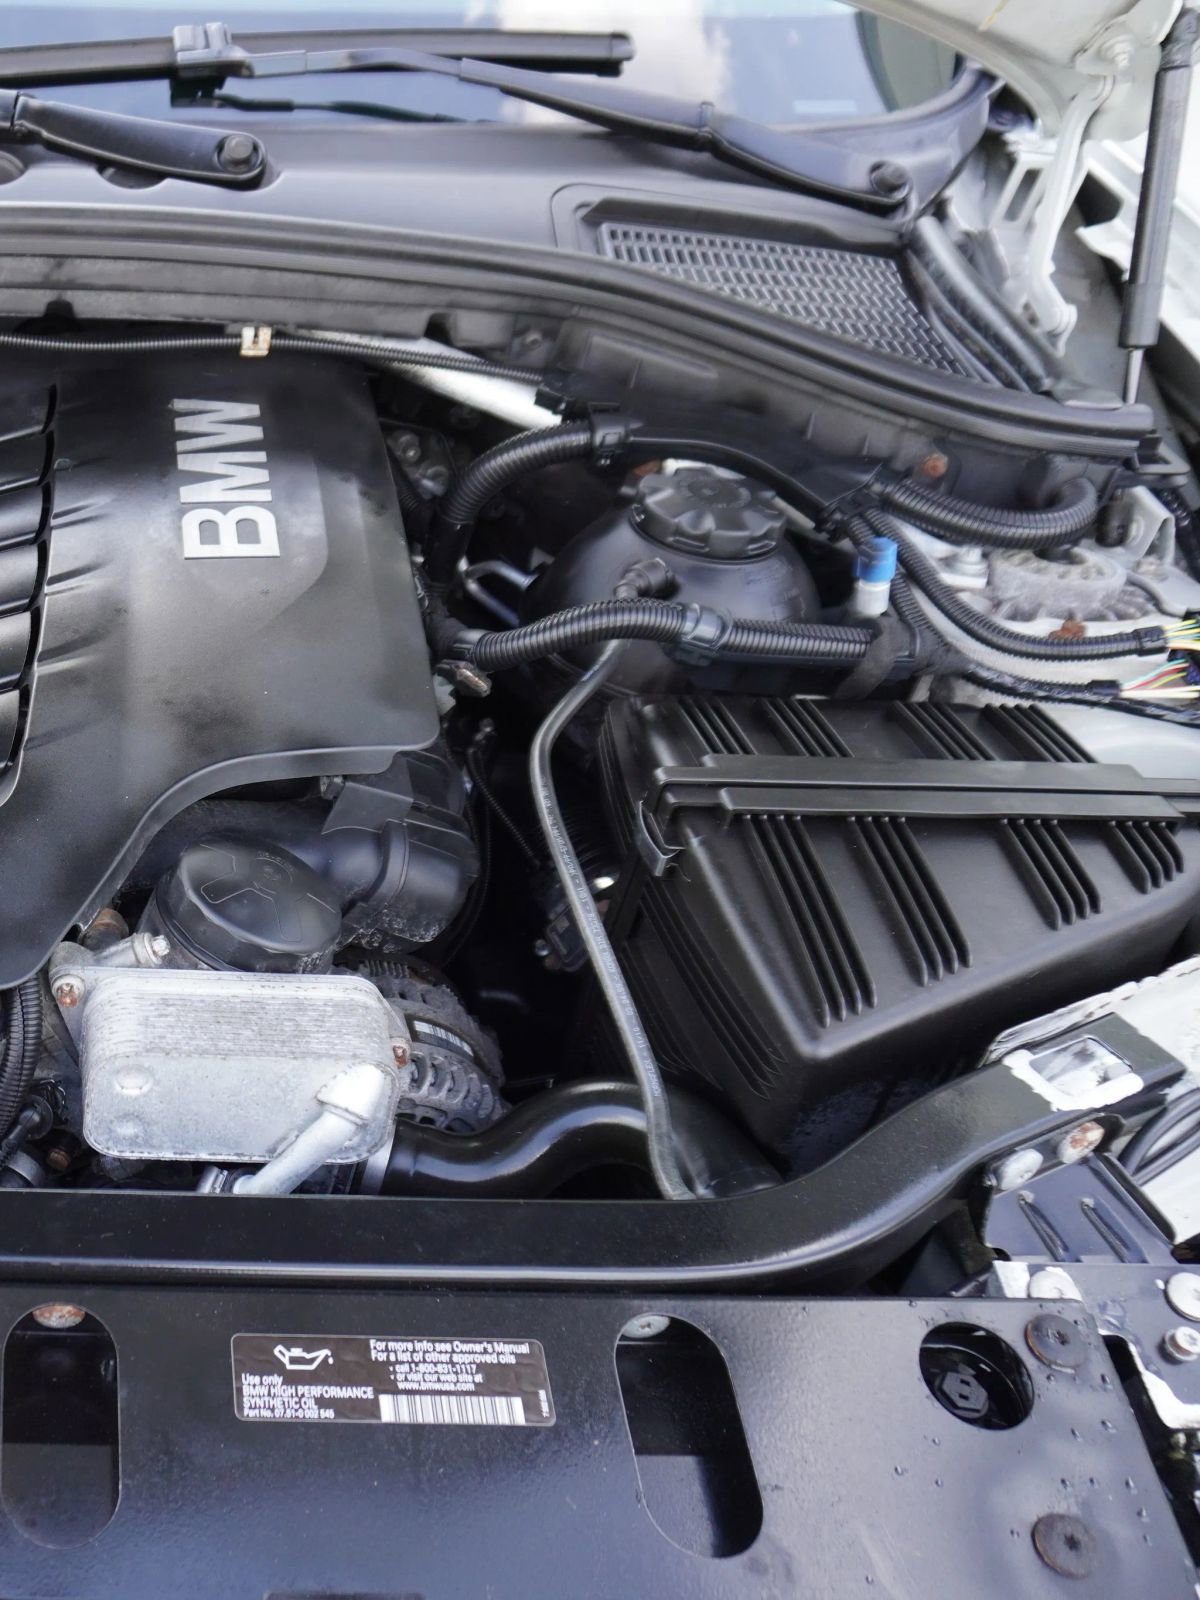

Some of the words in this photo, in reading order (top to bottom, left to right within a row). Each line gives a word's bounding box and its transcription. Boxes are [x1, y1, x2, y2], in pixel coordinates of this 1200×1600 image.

[173, 398, 280, 559] BMW
[369, 1339, 387, 1351] For
[387, 1341, 413, 1352] more
[414, 1340, 434, 1352] info
[434, 1342, 452, 1352] see
[452, 1341, 493, 1353] Owner's
[493, 1341, 530, 1354] Manual
[371, 1350, 388, 1361] For
[389, 1352, 396, 1361] a
[397, 1350, 412, 1362] list
[412, 1351, 424, 1362] of
[424, 1351, 451, 1363] other
[452, 1353, 498, 1365] approved
[498, 1354, 516, 1364] oils
[395, 1362, 410, 1373] call
[241, 1373, 261, 1385] Use
[262, 1374, 284, 1388] only
[396, 1373, 406, 1381] or
[473, 1373, 484, 1384] at
[242, 1384, 269, 1397] BMW
[270, 1385, 296, 1397] HIGH
[298, 1386, 375, 1399] PERFORMANCE
[396, 1381, 476, 1392] www.bmwusa.com
[243, 1396, 300, 1409] SYNTHETIC
[300, 1397, 318, 1410] OIL
[244, 1408, 260, 1417] Part
